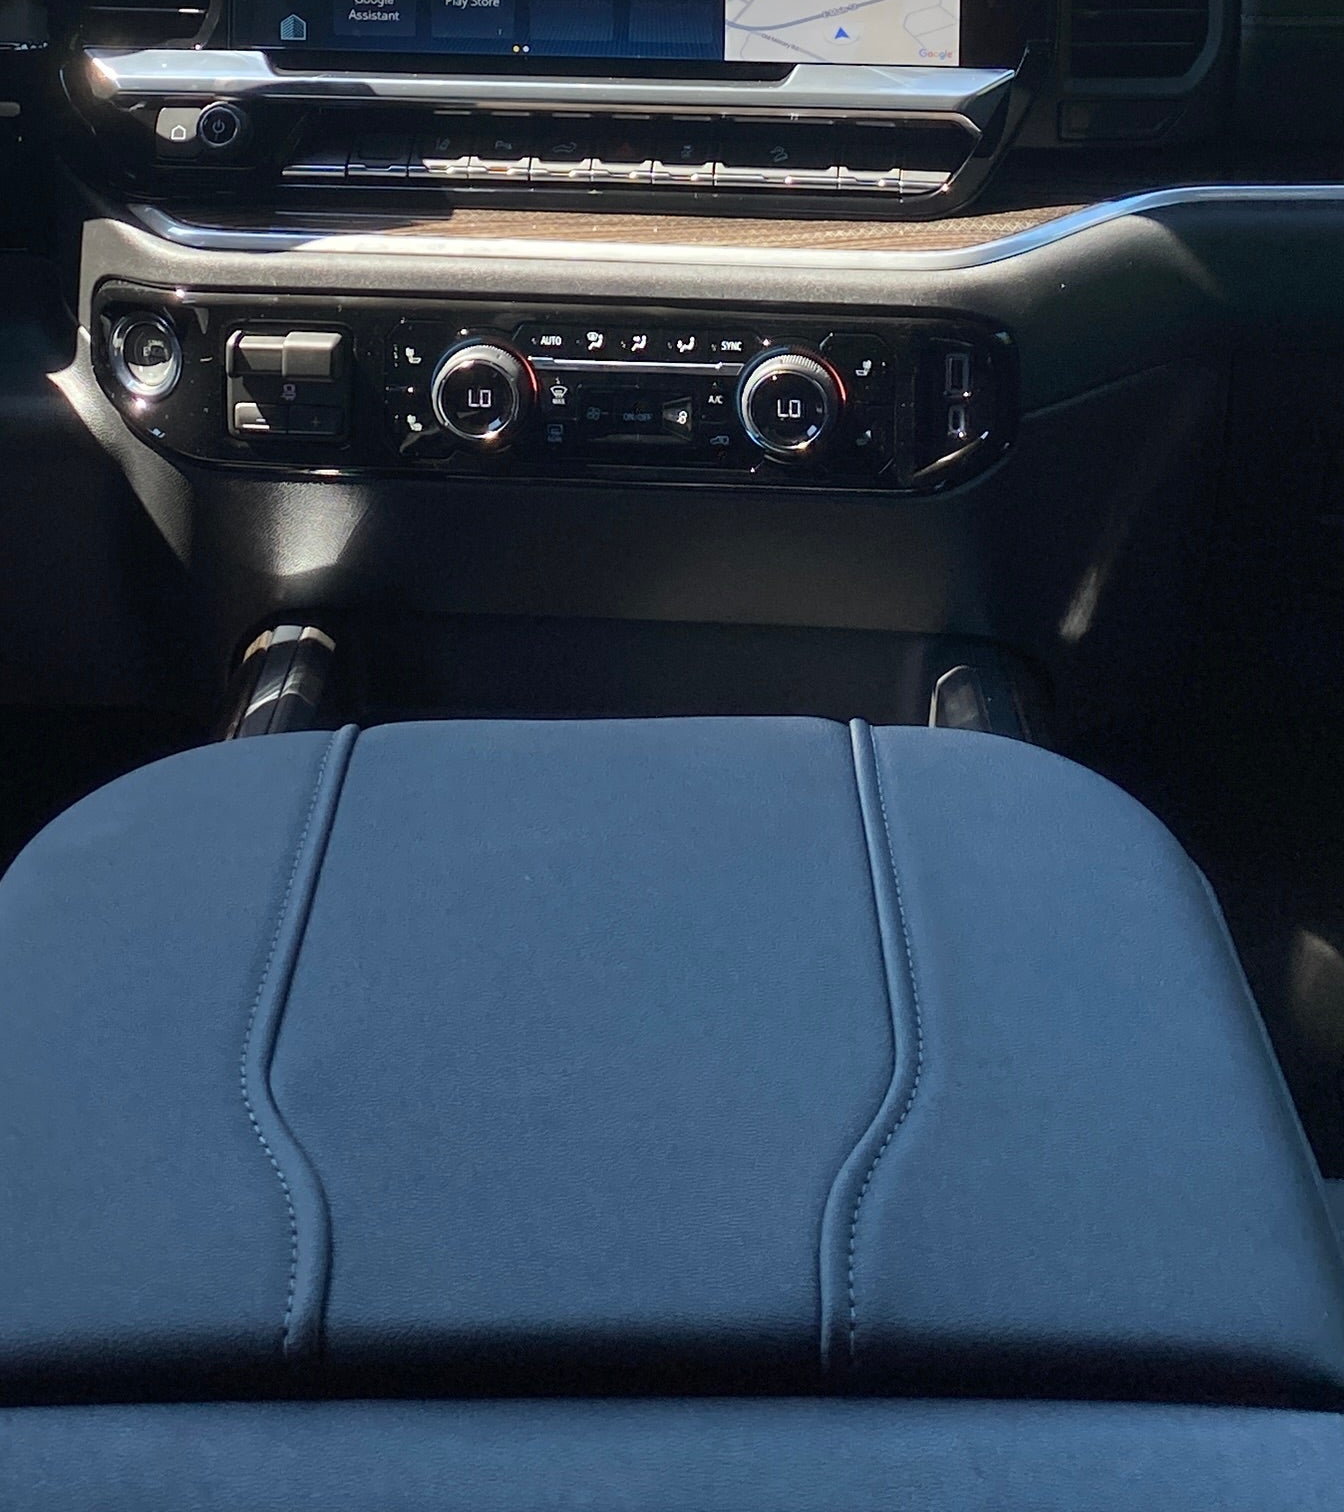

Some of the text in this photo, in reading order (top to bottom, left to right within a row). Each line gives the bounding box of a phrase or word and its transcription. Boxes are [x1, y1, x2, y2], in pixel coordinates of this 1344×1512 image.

[348, 9, 400, 21] Assistant
[919, 48, 953, 60] Google
[540, 336, 562, 346] AUTO
[721, 340, 743, 351] SYNC
[468, 389, 492, 408] LO
[708, 395, 723, 405] A/C
[777, 399, 801, 418] LO
